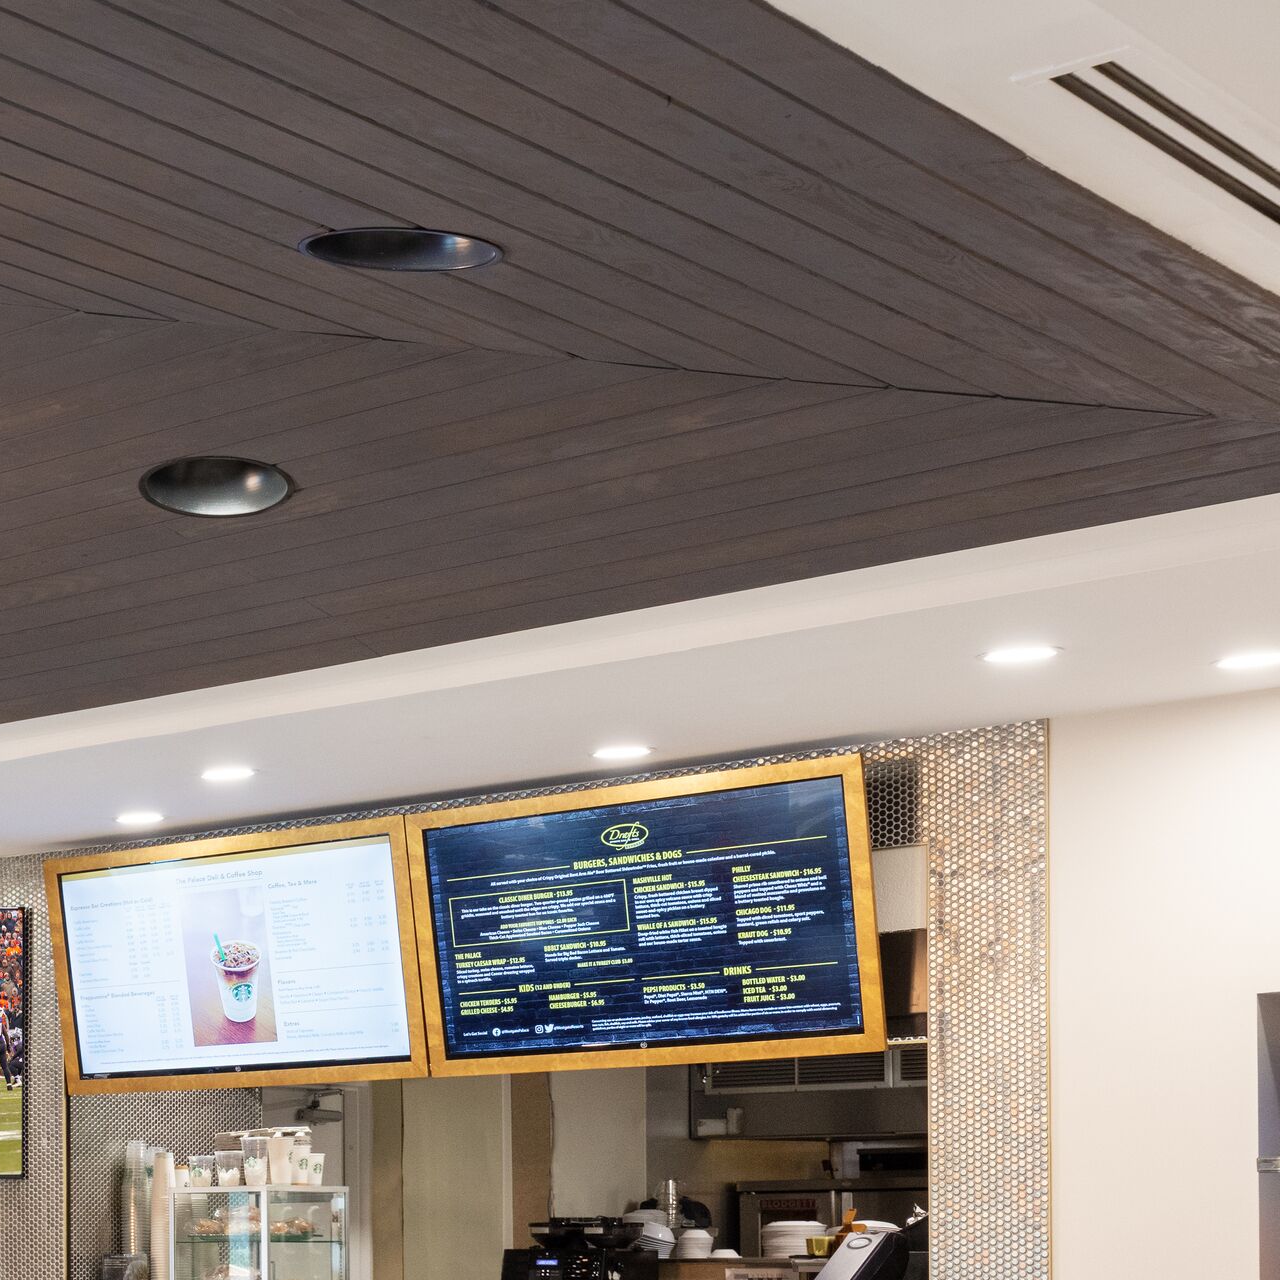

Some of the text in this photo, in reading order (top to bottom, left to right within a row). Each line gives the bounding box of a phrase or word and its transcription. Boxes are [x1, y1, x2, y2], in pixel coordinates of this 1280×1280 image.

[572, 858, 607, 870] BURGERS,
[607, 852, 654, 866] SANDWICHES
[662, 849, 682, 860] DOGS
[731, 865, 751, 874] PHILLY
[732, 866, 821, 883] CHEESESTEAK SANDWICH $16.95
[187, 874, 205, 885] Palace
[206, 873, 219, 882] Deli
[226, 870, 245, 880] Coffee
[246, 867, 263, 878] Shop
[632, 873, 672, 884] NASHVILLE HOT
[267, 881, 286, 890] Coffee,
[302, 877, 317, 886] More
[633, 879, 705, 894] CHICKEN SANDWICH $15.95
[498, 895, 517, 904] CLASSIC
[735, 903, 795, 916] CHICAGO DOG $11.95
[636, 922, 655, 931] WHALE
[699, 916, 717, 925] $15.95
[737, 927, 791, 939] KRAUT DOG $10.95
[559, 941, 586, 950] SANDWICH
[464, 951, 481, 959] PALACE
[455, 961, 473, 969] TURKEY
[473, 959, 491, 967] CAESAR
[723, 965, 751, 975] DRINKS
[741, 973, 805, 986] BOTTLED WATER $3.00
[518, 983, 534, 993] KIDS
[658, 983, 686, 992] PRODUCTS
[771, 984, 787, 992] $3.00
[548, 992, 580, 1001] HAMBURGER
[743, 992, 795, 1003] FRUIT JUICE $3.00
[459, 1000, 480, 1008] CHICKEN
[480, 998, 501, 1006] TENDERS
[549, 1000, 587, 1009] CHEESEBURGER
[460, 1008, 480, 1016] GRILLED
[480, 1006, 498, 1014] CHEESE
